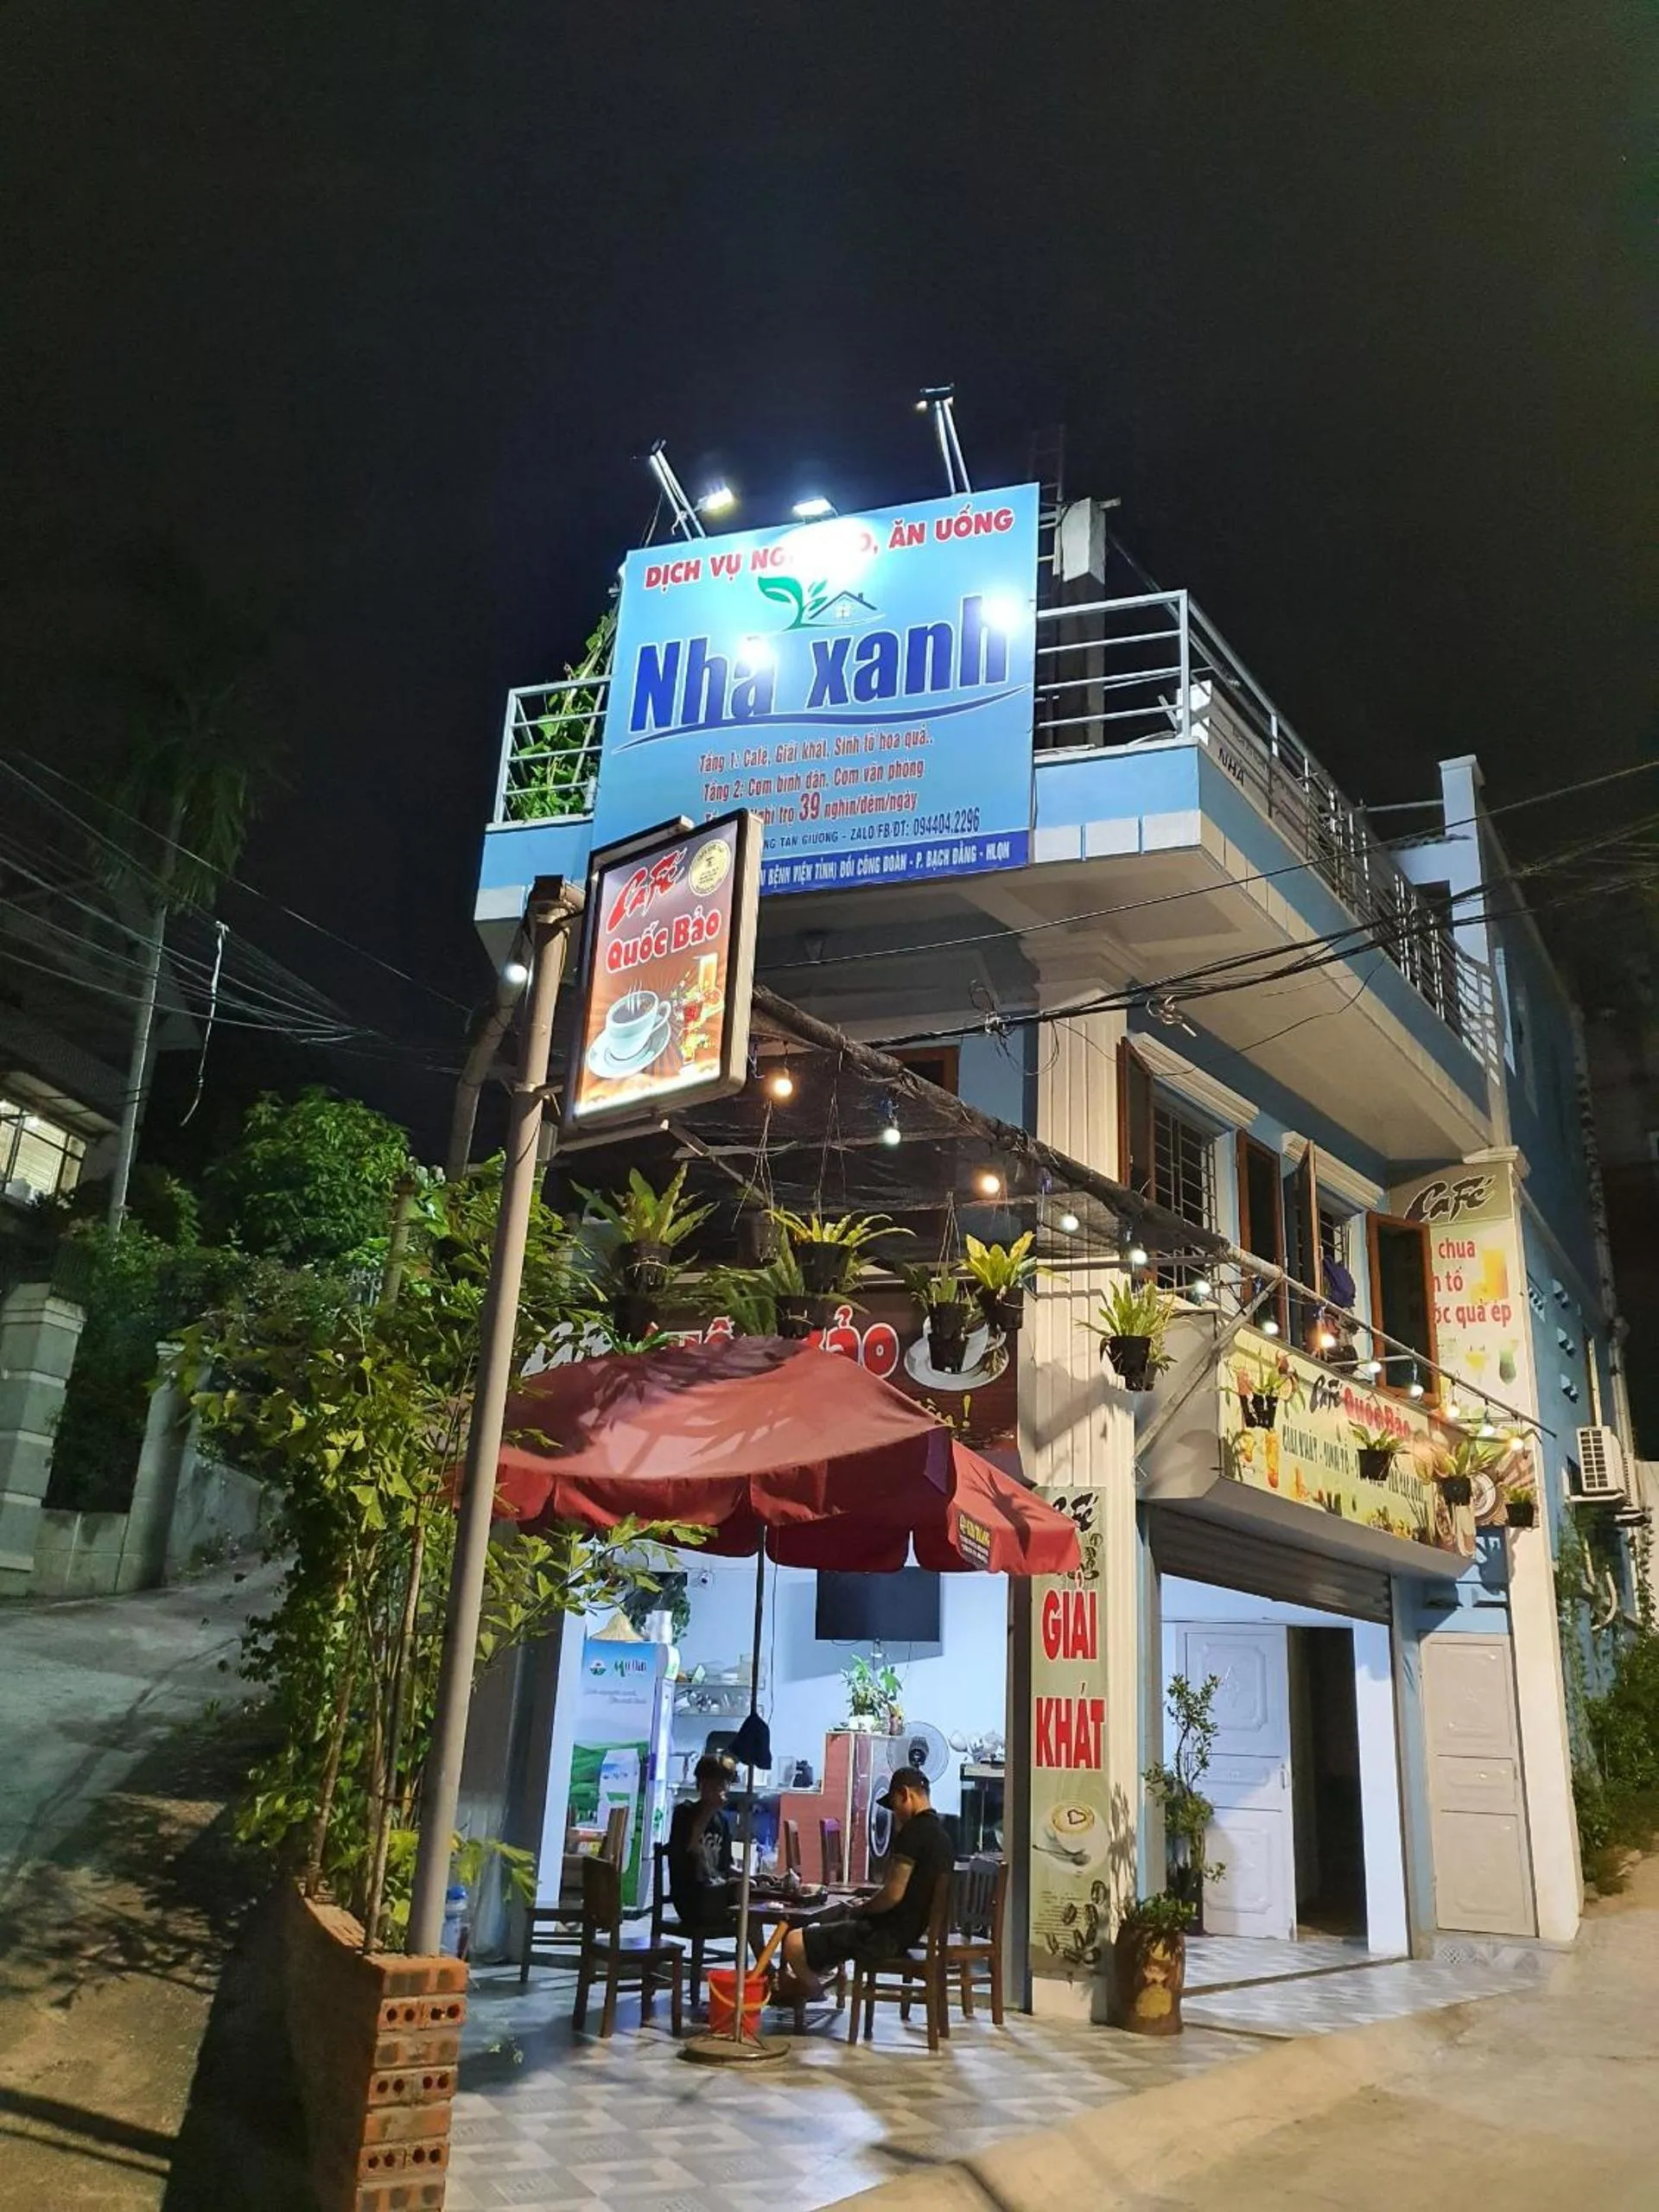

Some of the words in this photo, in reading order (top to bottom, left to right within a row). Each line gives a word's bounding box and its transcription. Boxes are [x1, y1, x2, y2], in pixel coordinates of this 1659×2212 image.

[645, 559, 702, 592] DỊCH
[710, 553, 741, 582] VỤ
[888, 519, 926, 549] ĂN
[935, 504, 1014, 541] UỐNG
[806, 594, 1009, 709] xanh
[798, 791, 822, 822] 39
[913, 806, 981, 836] 094404.2296
[606, 919, 669, 975] Quốc
[671, 905, 721, 953] Bảo
[1438, 1236, 1476, 1259] chua
[1445, 1265, 1464, 1293] tố
[1455, 1297, 1487, 1329] quả
[1491, 1300, 1512, 1328] ép
[1040, 1568, 1099, 1662] GIẢI
[1035, 1681, 1106, 1770] KHÁT
